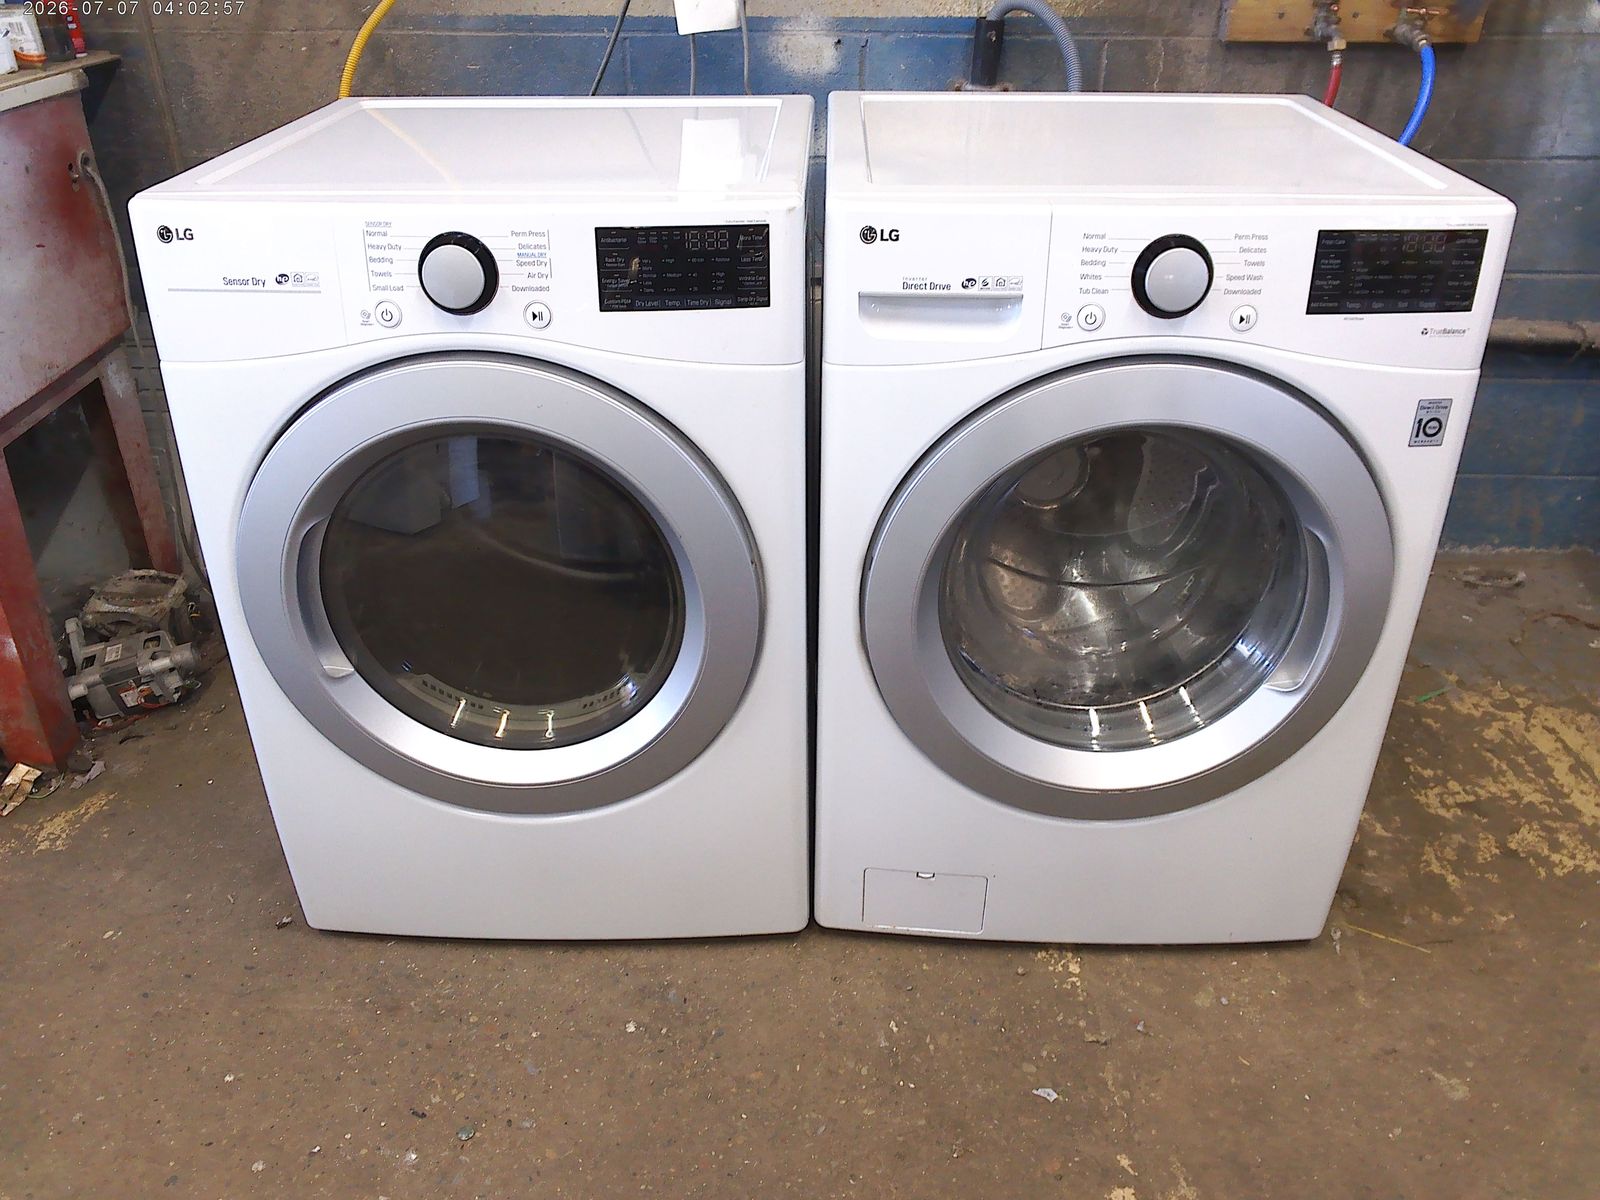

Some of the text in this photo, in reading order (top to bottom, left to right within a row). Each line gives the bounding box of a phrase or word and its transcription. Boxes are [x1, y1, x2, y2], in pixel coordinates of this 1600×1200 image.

[175, 228, 194, 240] LG
[880, 229, 900, 242] LG
[222, 277, 266, 288] Sensor Dry
[902, 282, 952, 291] Direct Drive
[1415, 417, 1443, 438] 10
